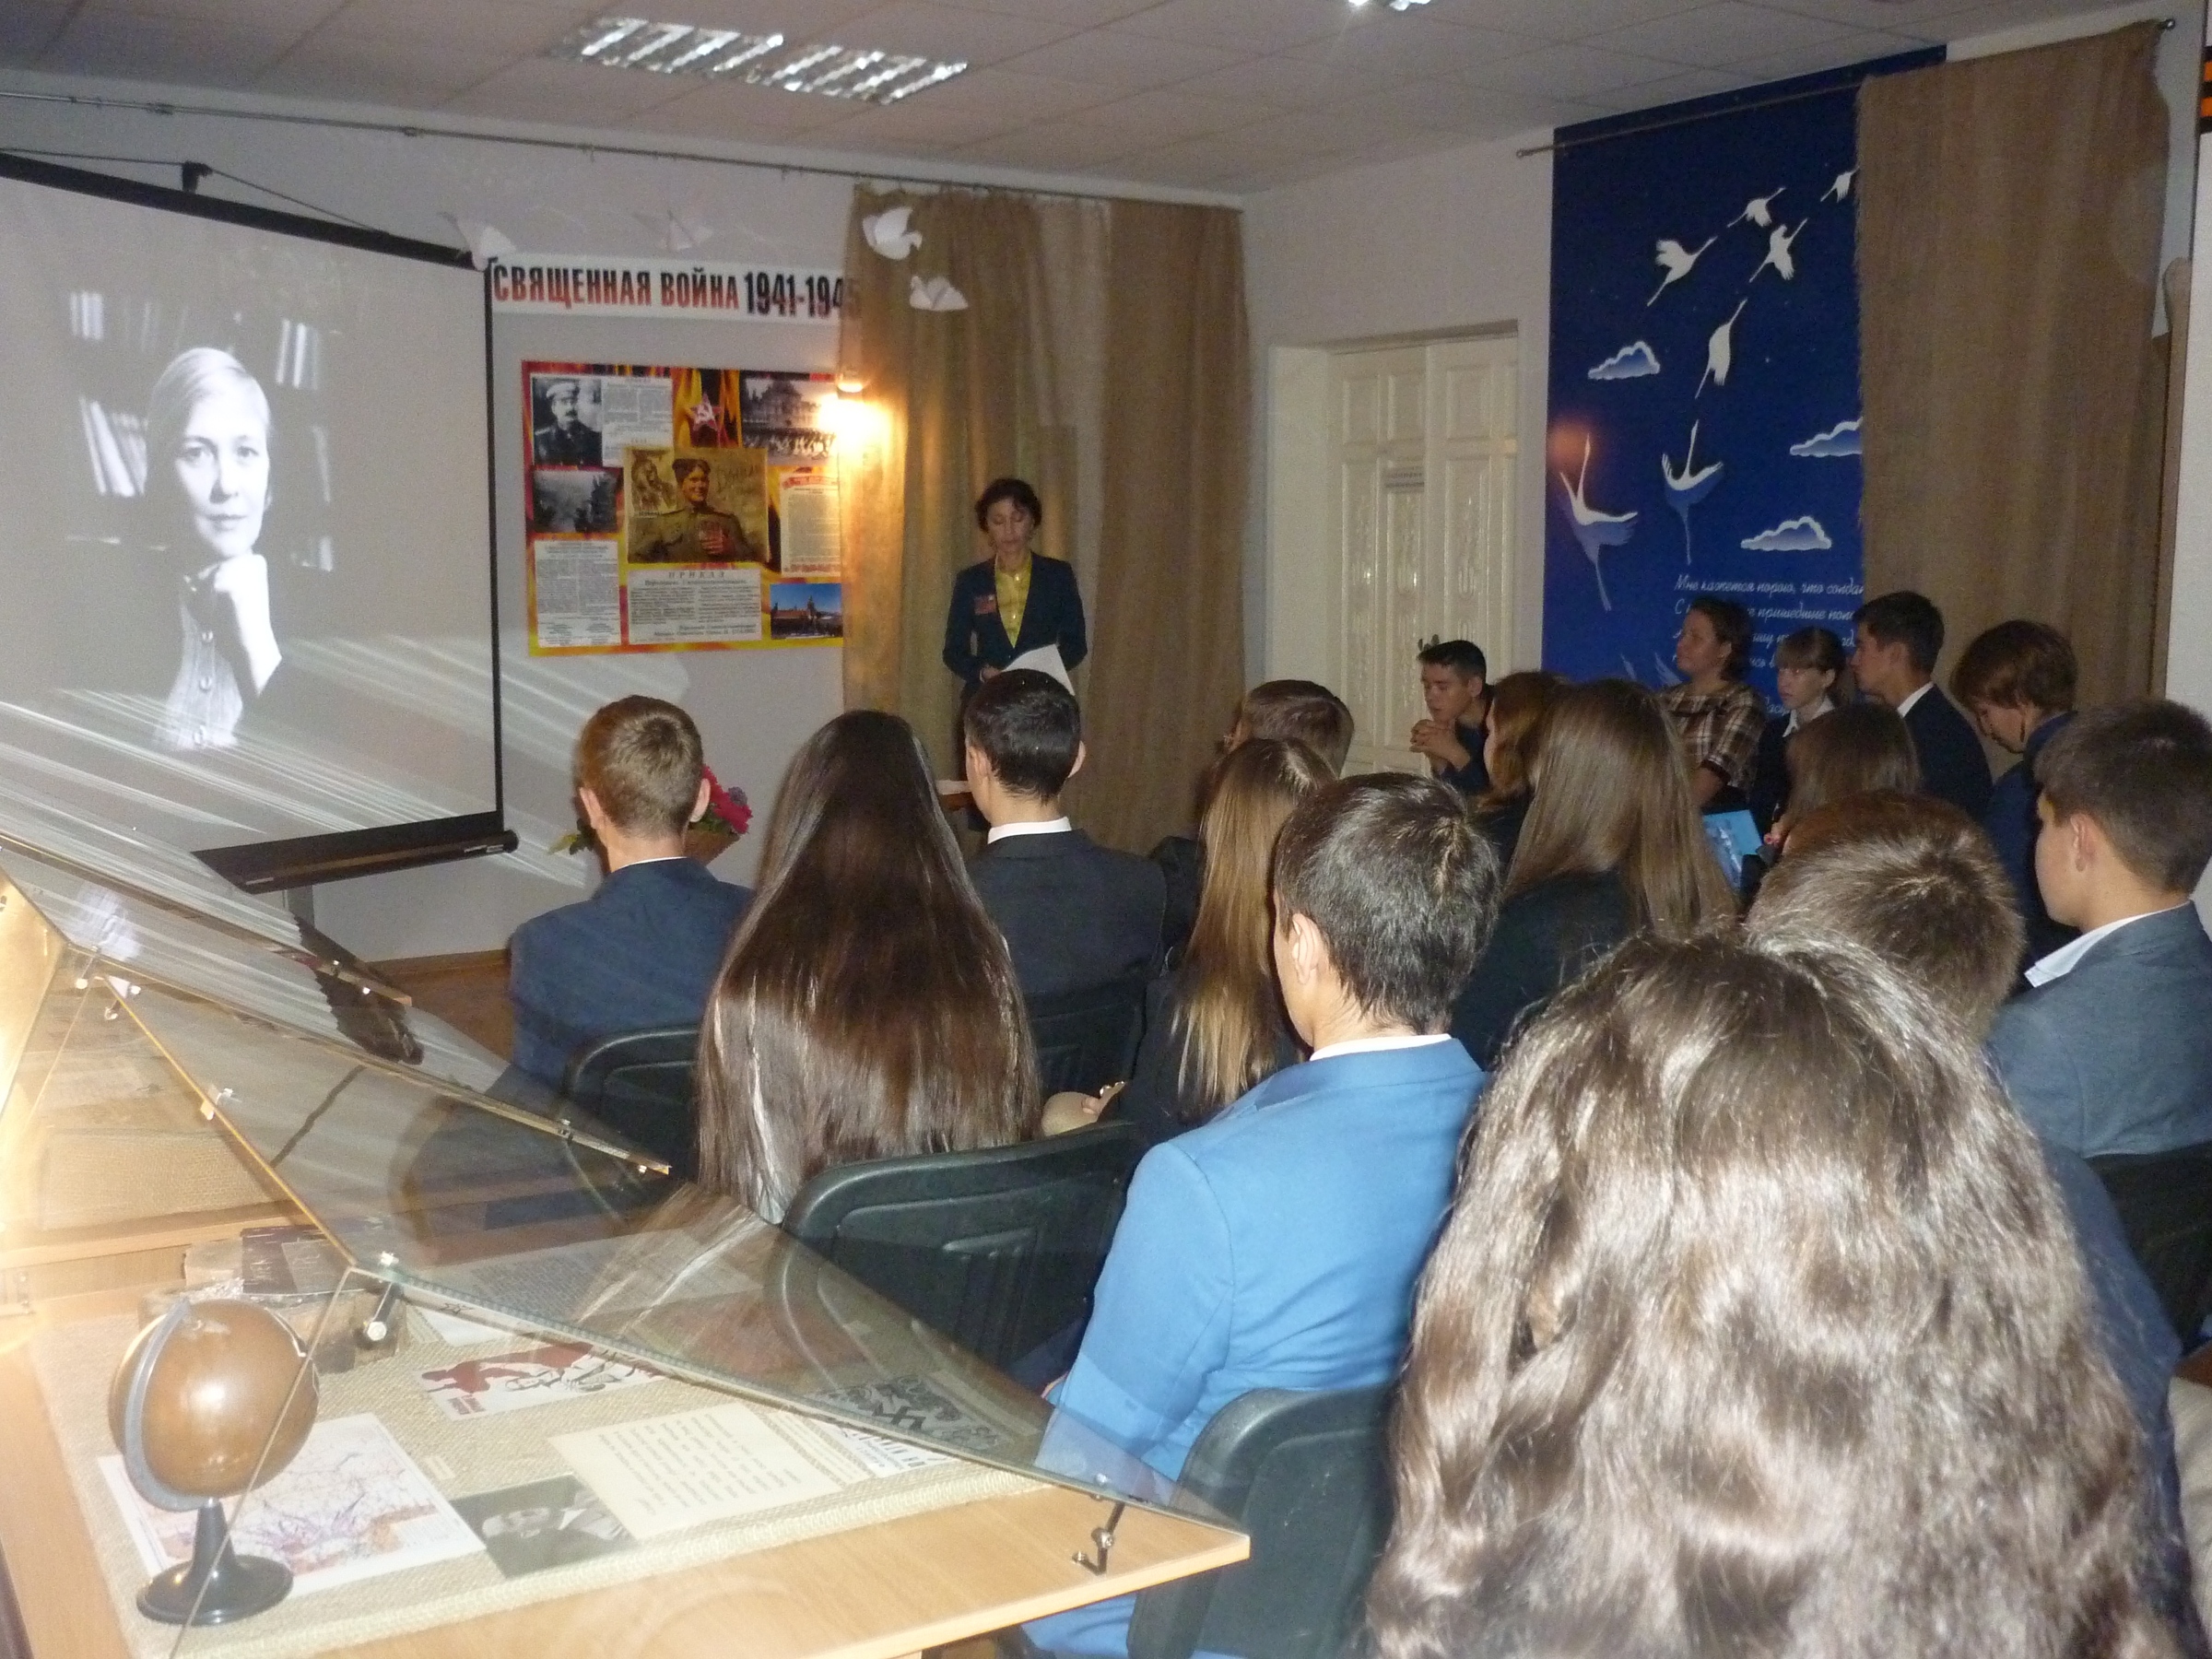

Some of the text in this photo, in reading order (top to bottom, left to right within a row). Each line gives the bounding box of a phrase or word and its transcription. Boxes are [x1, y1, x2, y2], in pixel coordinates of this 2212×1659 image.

[493, 264, 844, 319] СВЯЩЕННАЯ ВОЙНА 1941-194
[1674, 573, 1698, 591] Мне
[1700, 580, 1755, 592] кажется
[1802, 582, 1823, 594] что
[1758, 601, 1826, 623] пришедшие
